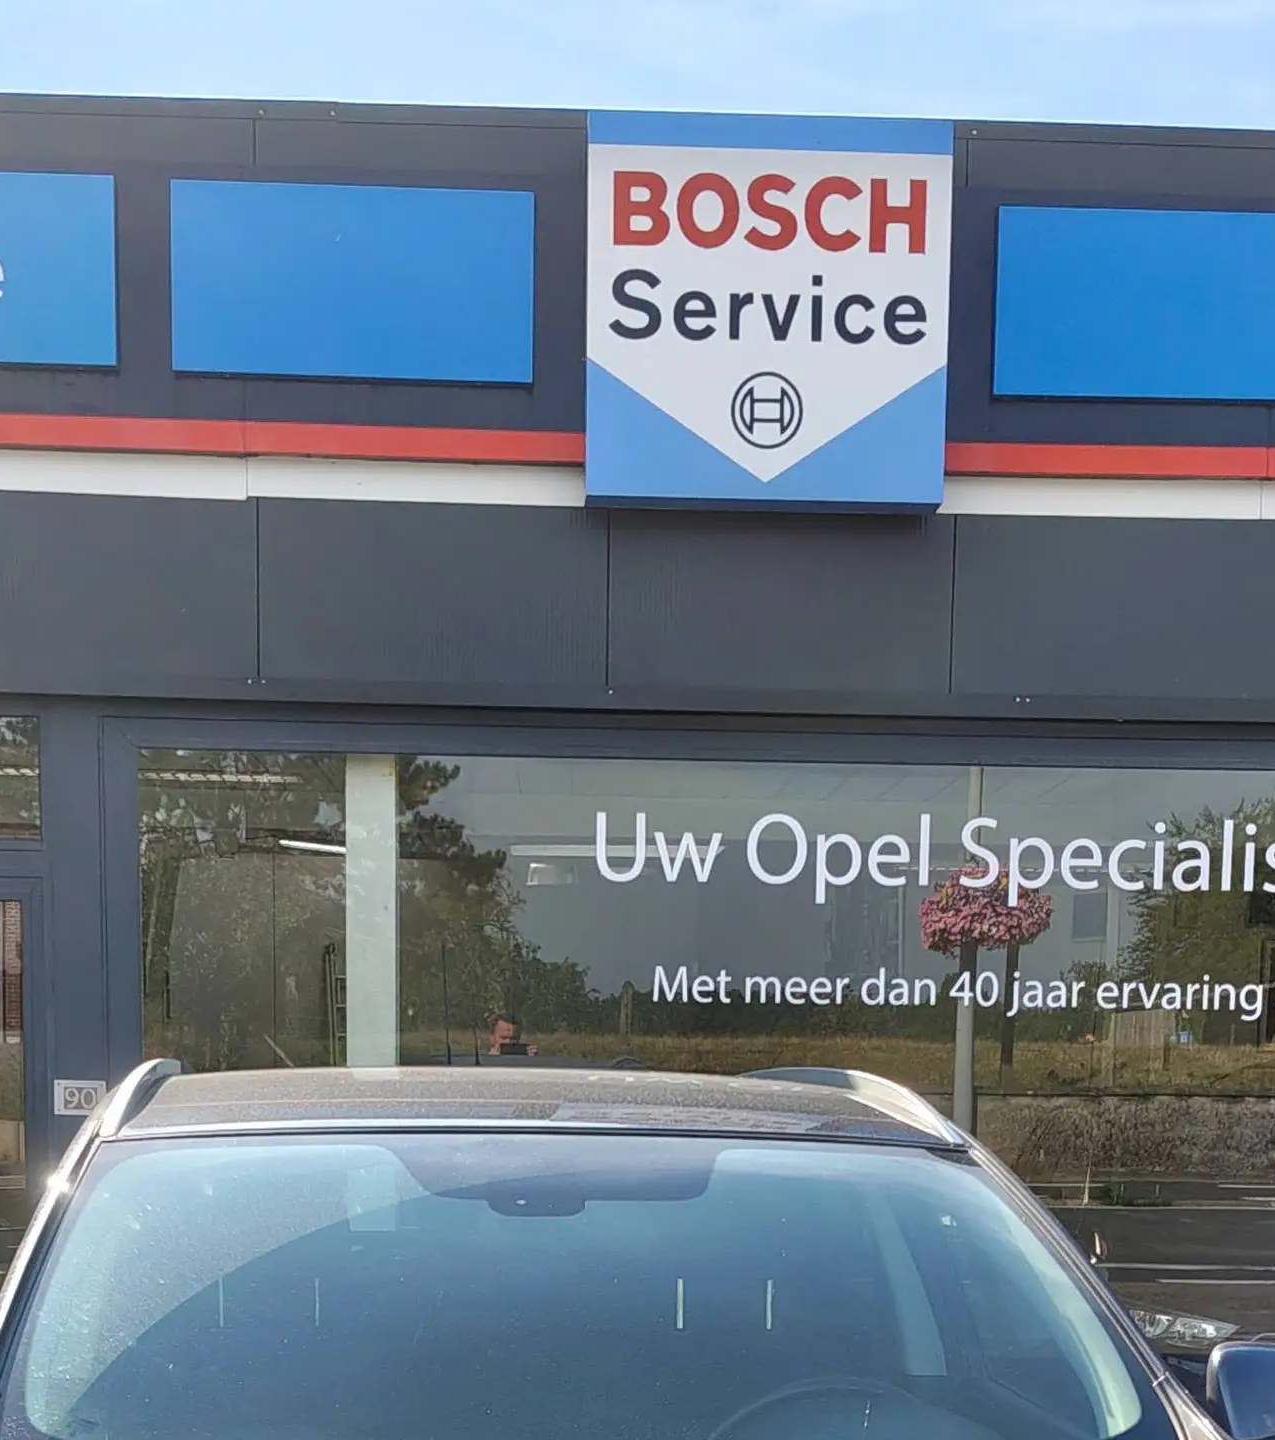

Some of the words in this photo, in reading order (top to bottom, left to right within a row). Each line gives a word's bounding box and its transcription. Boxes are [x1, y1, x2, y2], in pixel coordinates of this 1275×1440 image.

[612, 170, 928, 255] BOSCH
[608, 268, 928, 346] Service
[595, 810, 723, 884] Uw
[746, 812, 932, 905] Opel
[651, 964, 733, 1006] Met
[744, 975, 851, 1006] meer
[860, 966, 937, 1007] dan
[949, 970, 1000, 1008] 40
[1006, 970, 1087, 1018] jaar
[1095, 973, 1265, 1022] ervaring
[65, 1087, 96, 1109] 90
